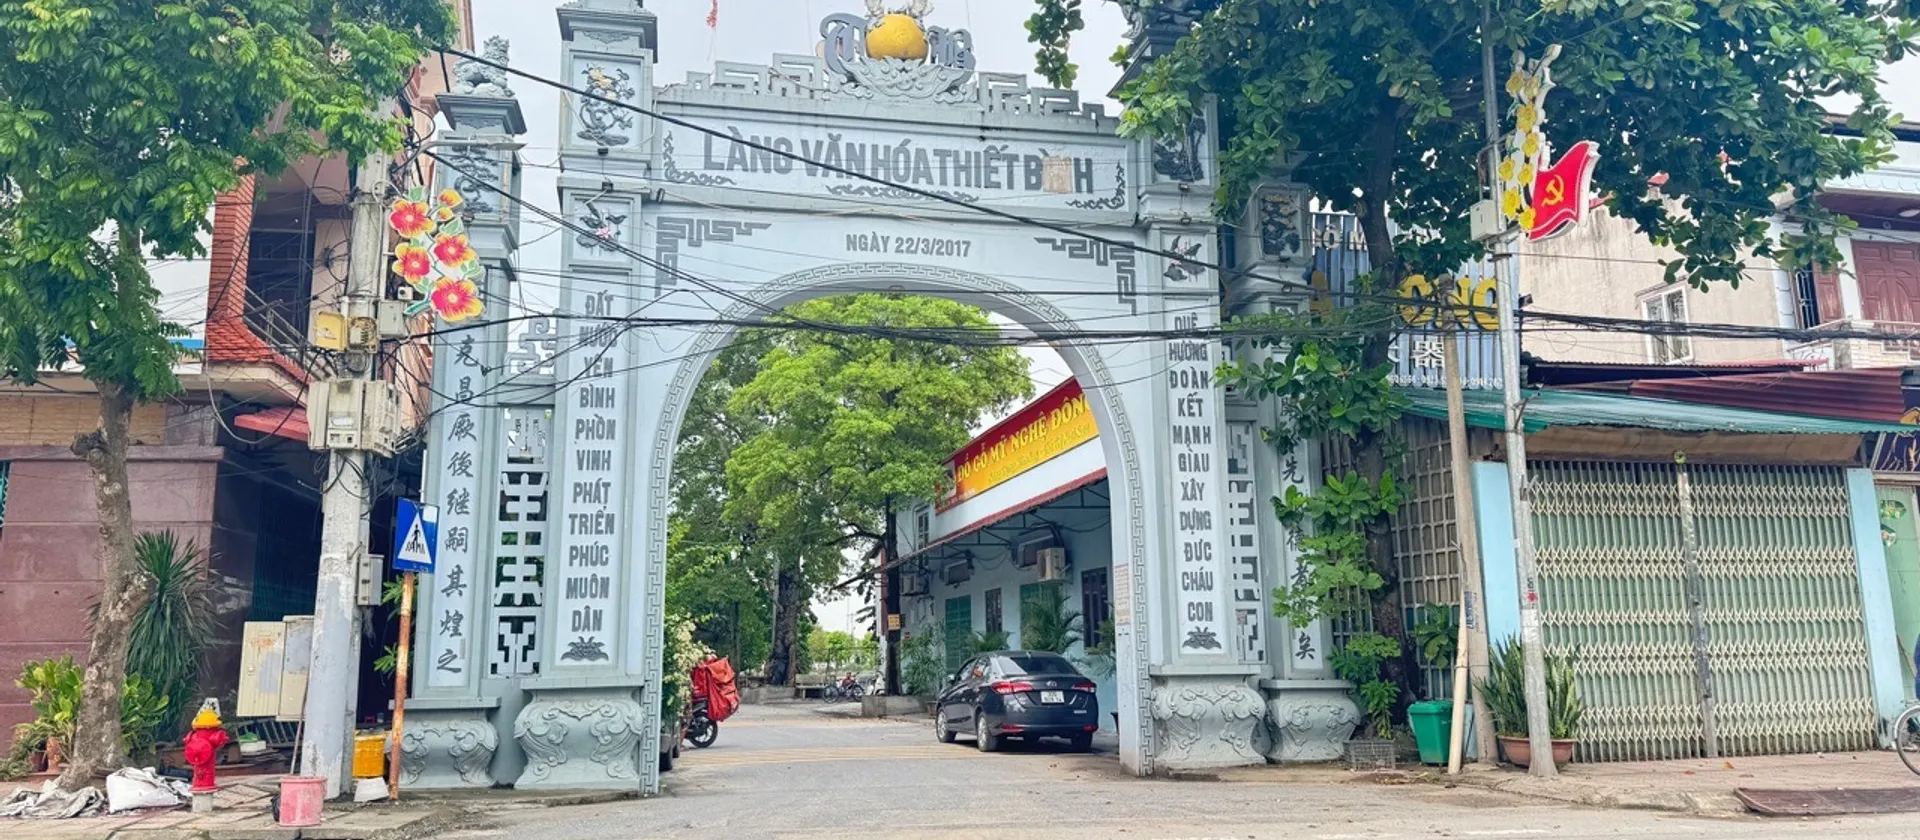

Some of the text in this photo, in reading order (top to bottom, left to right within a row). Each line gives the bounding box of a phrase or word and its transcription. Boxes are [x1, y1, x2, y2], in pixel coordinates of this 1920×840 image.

[703, 126, 793, 175] LÀNG
[800, 132, 866, 180] VĂN
[871, 138, 934, 186] HÓA
[933, 144, 1020, 190] THIẾT
[846, 231, 971, 257] NGÀY 22/3/2017
[585, 290, 614, 316] ĐẤT
[584, 353, 614, 378] YÊN
[1169, 366, 1209, 389] ĐOÀN
[579, 384, 616, 409] BÌNH
[1177, 391, 1204, 418] KẾT
[575, 413, 616, 441] PHỒN
[1010, 411, 1049, 453] NGHỆ
[1050, 393, 1091, 430] ĐÔN
[1172, 425, 1212, 448] MẠNH
[576, 450, 612, 471] VINH
[573, 477, 611, 504] PHÁT
[1180, 478, 1205, 501] XÂY
[569, 505, 616, 536] TRIỂN
[1179, 508, 1212, 535] DỰNG
[569, 541, 610, 567] PHÚC
[566, 573, 610, 600] MUÔN
[1181, 566, 1213, 591] CHÁU
[571, 605, 603, 632] DÂN
[1187, 601, 1213, 622] CON
